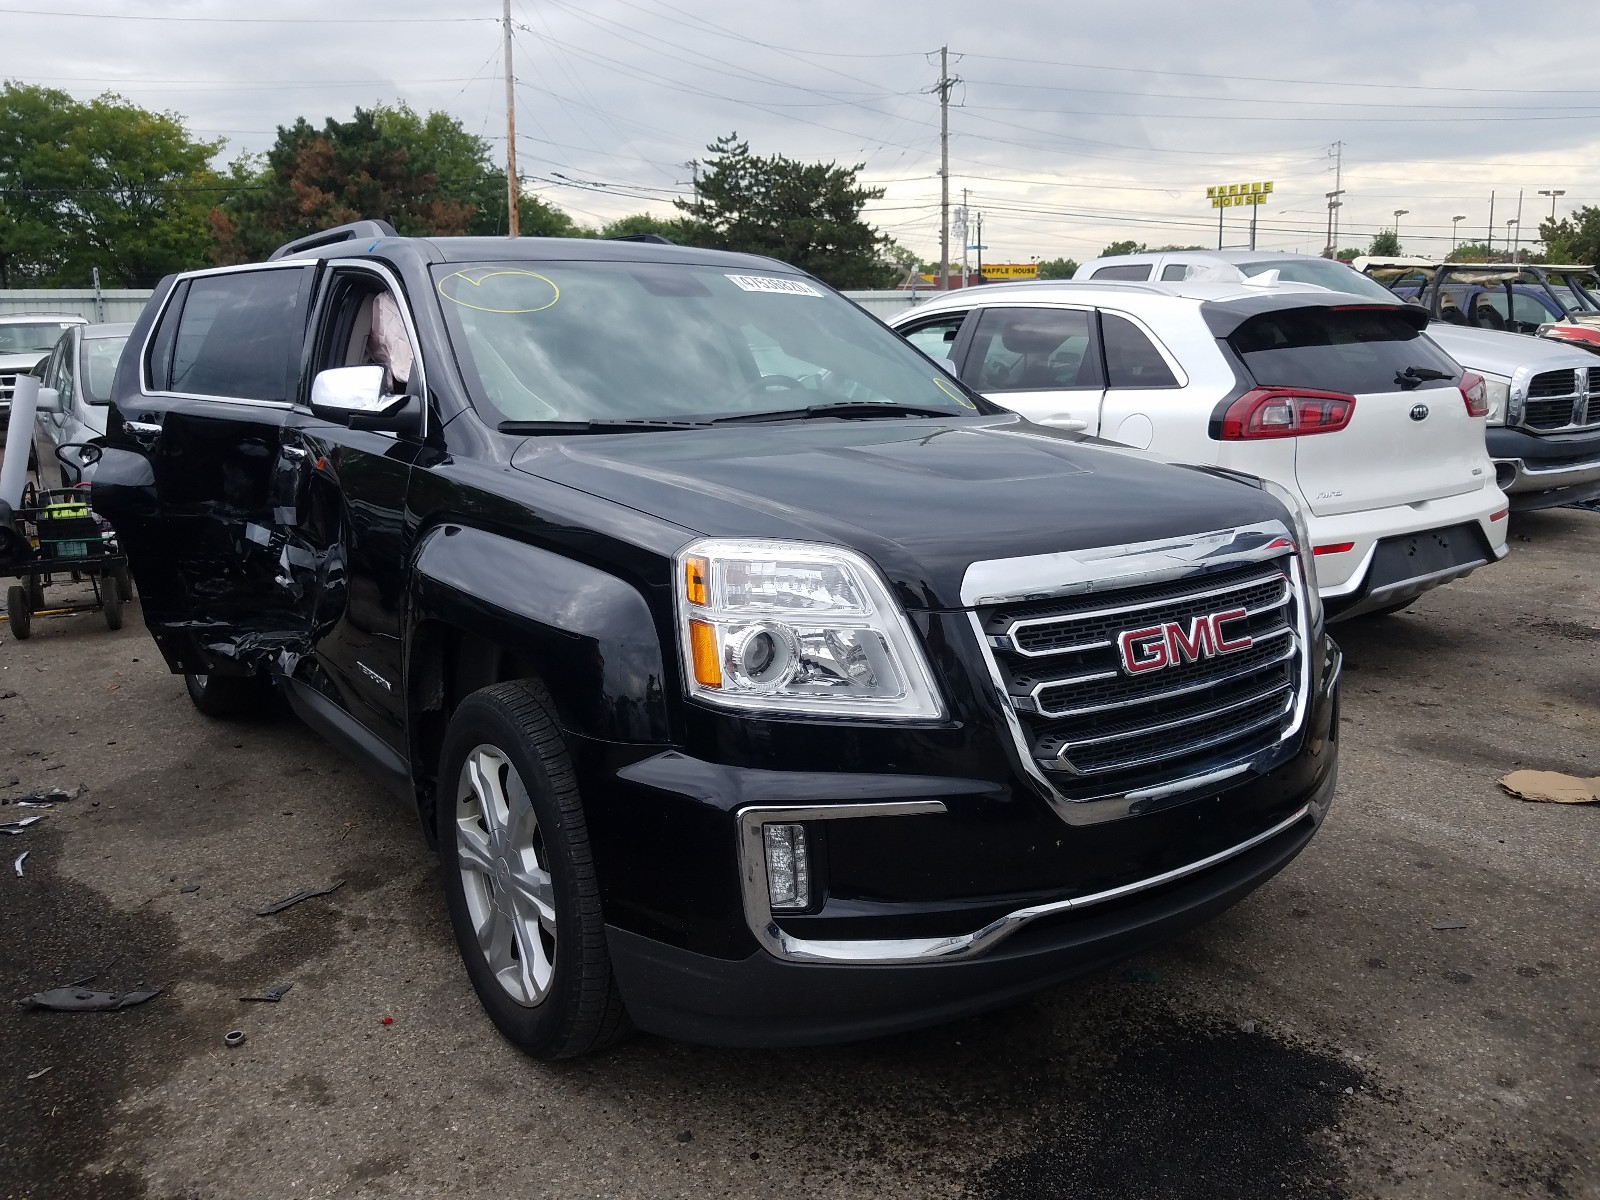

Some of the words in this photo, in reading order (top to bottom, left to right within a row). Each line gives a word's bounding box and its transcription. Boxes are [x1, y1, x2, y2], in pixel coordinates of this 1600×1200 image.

[1207, 182, 1272, 196] WAFFLE
[1212, 195, 1265, 207] HOUSE
[1118, 607, 1253, 676] GMC
